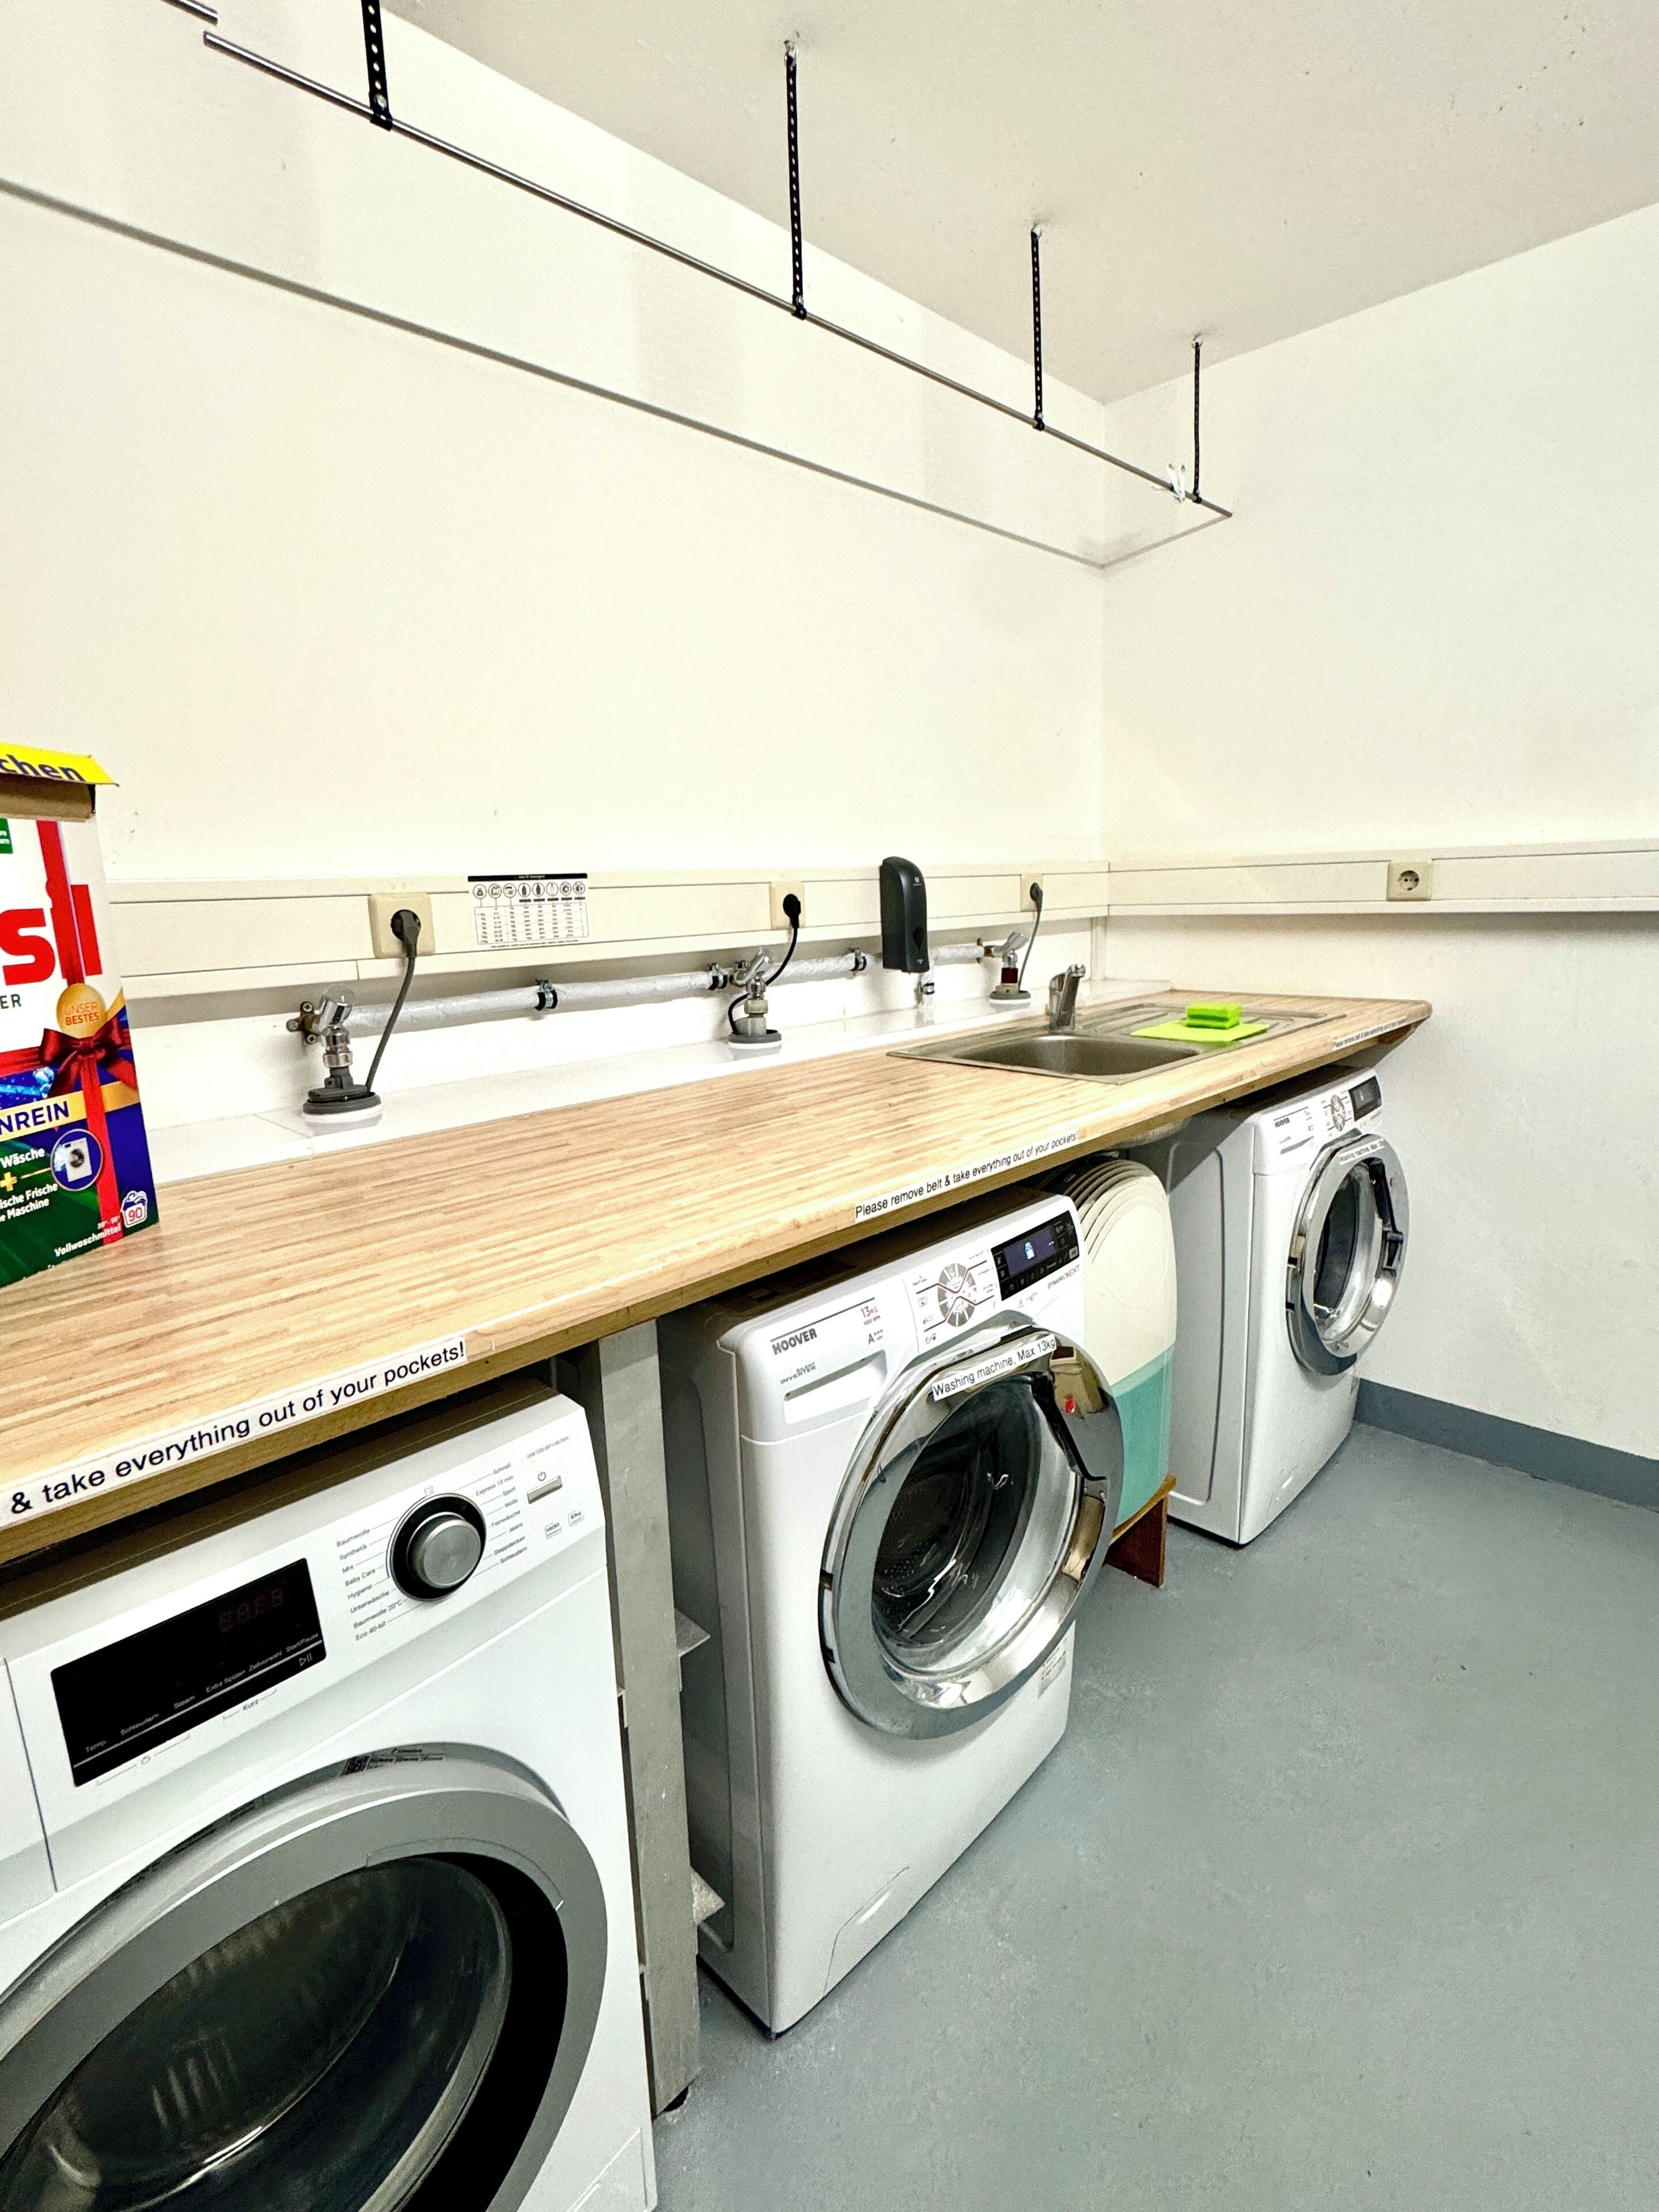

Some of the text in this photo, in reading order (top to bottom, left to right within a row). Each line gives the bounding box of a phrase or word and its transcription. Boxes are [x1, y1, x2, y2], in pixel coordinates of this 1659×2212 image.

[0, 994, 22, 1009] ER
[63, 1001, 99, 1016] UNSER
[65, 1012, 100, 1026] BESTES
[0, 1101, 69, 1135] NREIN
[1, 1148, 45, 1168] Wäsche
[855, 1199, 888, 1218] Please
[891, 1187, 924, 1205] remove
[926, 1177, 942, 1194] belt
[944, 1175, 950, 1186] &
[953, 1170, 970, 1184] take
[972, 1154, 1011, 1176] everything
[1013, 1150, 1024, 1162] out
[1027, 1146, 1033, 1157] of
[1035, 1142, 1050, 1156] your
[25, 1183, 58, 1200] Frische
[6, 1198, 50, 1219] Maschine
[128, 1207, 143, 1222] 90
[54, 1222, 122, 1257] Vollwaschmittel
[772, 1328, 817, 1355] HOOVER
[781, 1365, 816, 1384] INVERTER
[933, 1339, 1055, 1397] Washing machine, Max 13kg
[12, 1341, 465, 1514] & take everything out of your pockets!
[475, 1484, 496, 1497] Express
[497, 1478, 503, 1486] 15
[502, 1486, 516, 1497] Sport
[339, 1544, 368, 1561] Synthetik
[345, 1569, 376, 1587] Baby Care
[347, 1584, 373, 1600] Hygiene
[355, 1620, 386, 1641] Eco 40-60
[242, 1699, 259, 1711] Kurz
